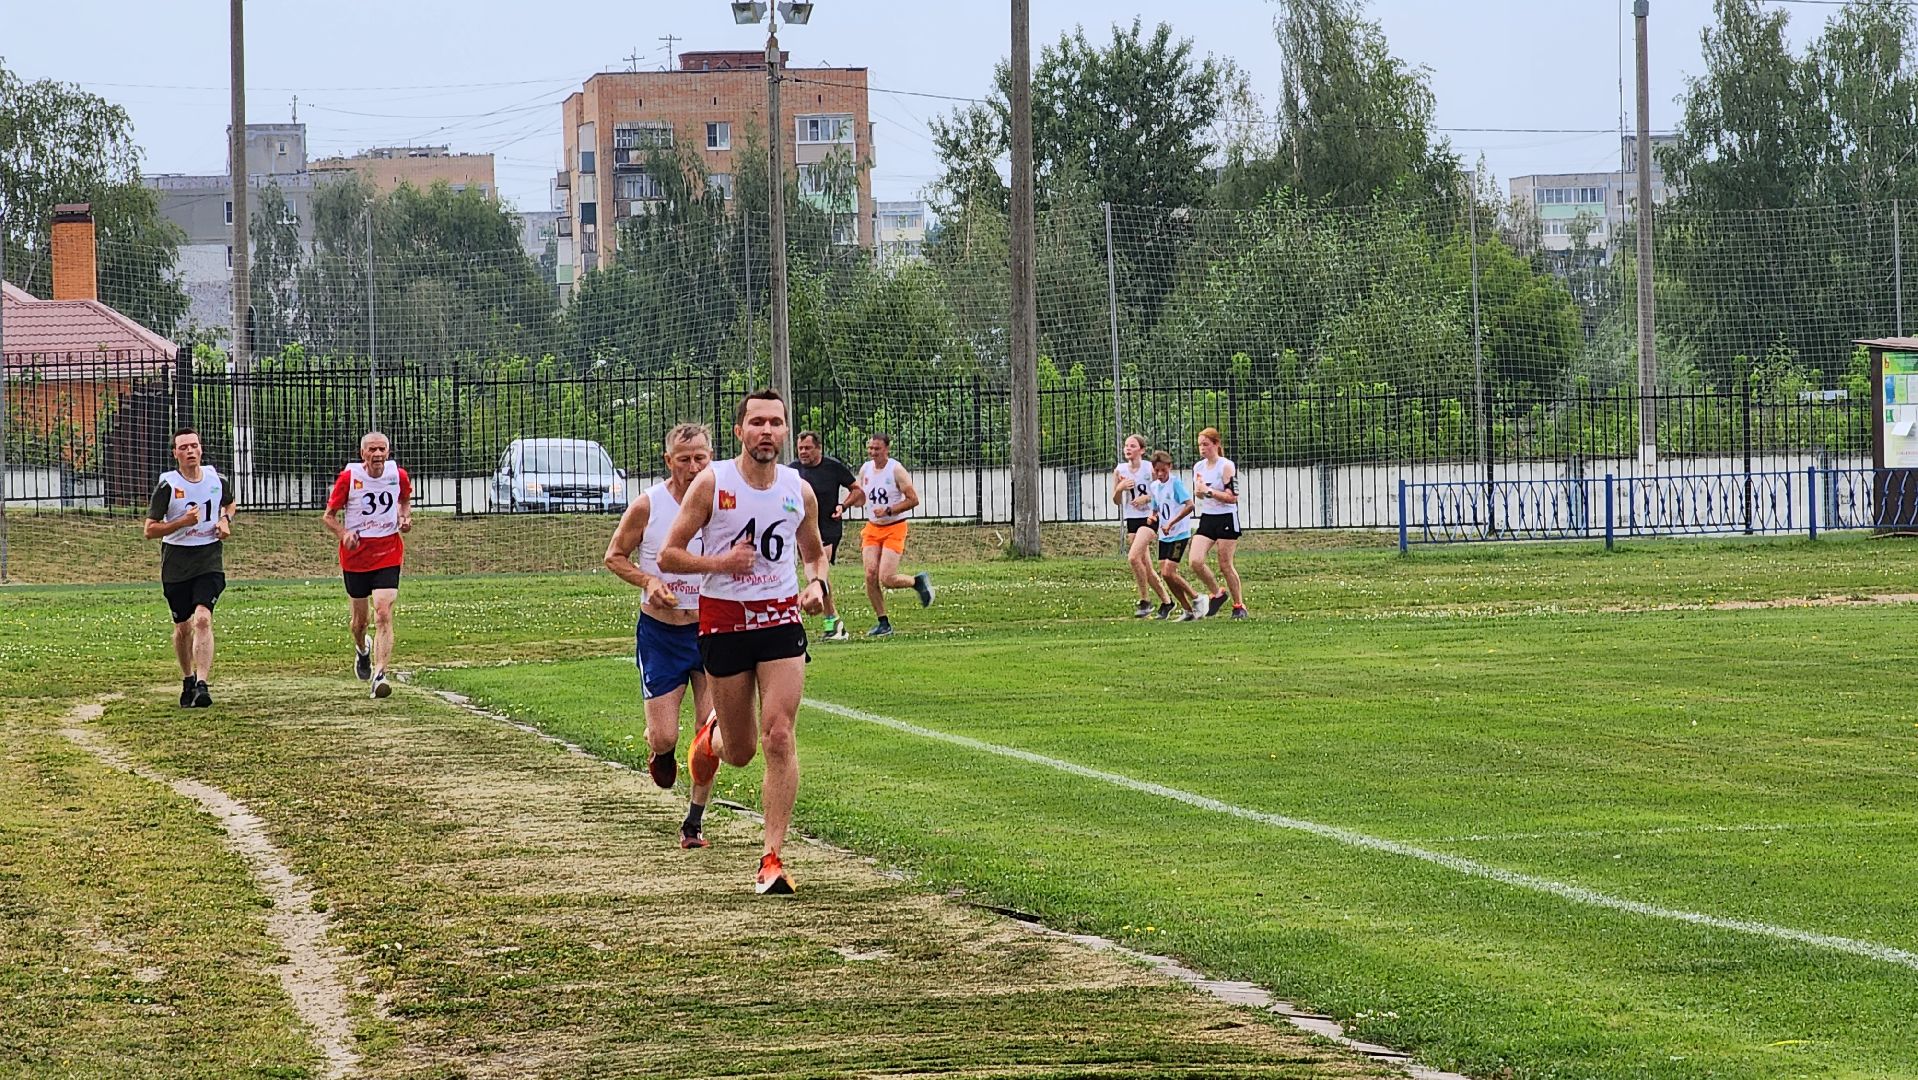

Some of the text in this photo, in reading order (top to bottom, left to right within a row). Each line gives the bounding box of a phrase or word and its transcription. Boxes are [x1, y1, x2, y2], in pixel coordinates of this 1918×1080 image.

[361, 491, 394, 516] 39
[869, 486, 889, 504] 48
[730, 517, 787, 562] 46
